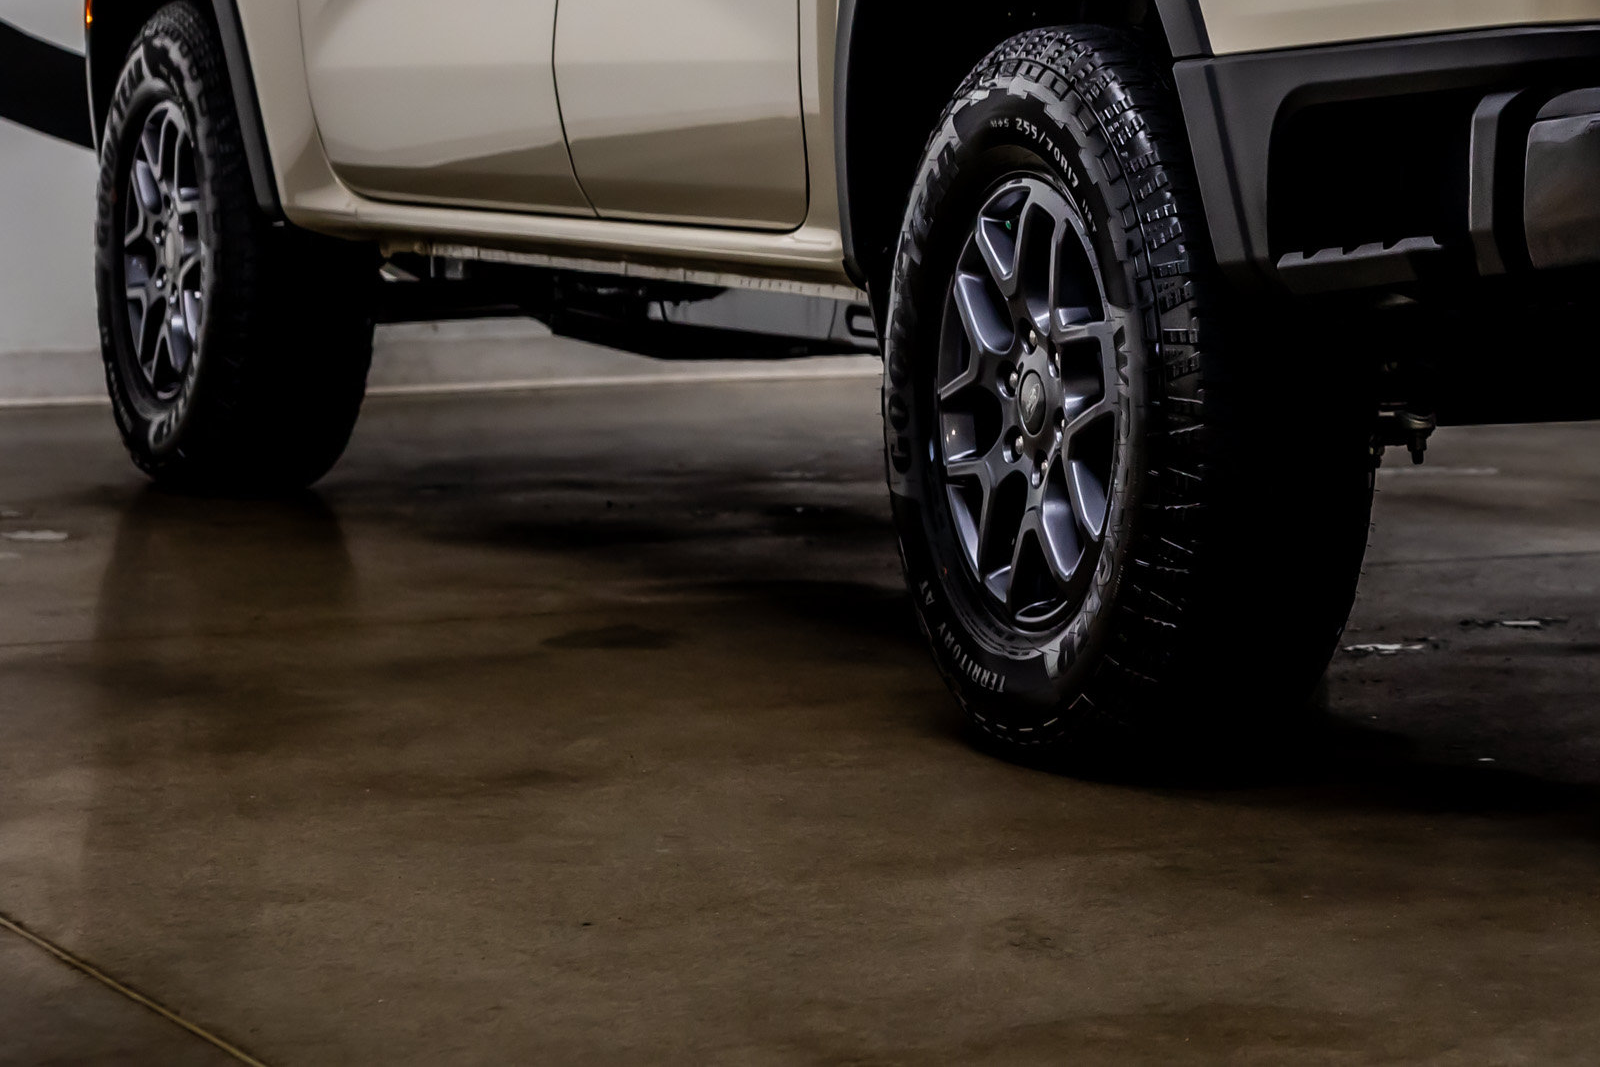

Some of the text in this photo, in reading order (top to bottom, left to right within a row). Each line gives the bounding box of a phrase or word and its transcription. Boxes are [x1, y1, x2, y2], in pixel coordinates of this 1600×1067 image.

[1015, 116, 1080, 189] 255/70R17
[918, 579, 1006, 693] TERRITORY AT
